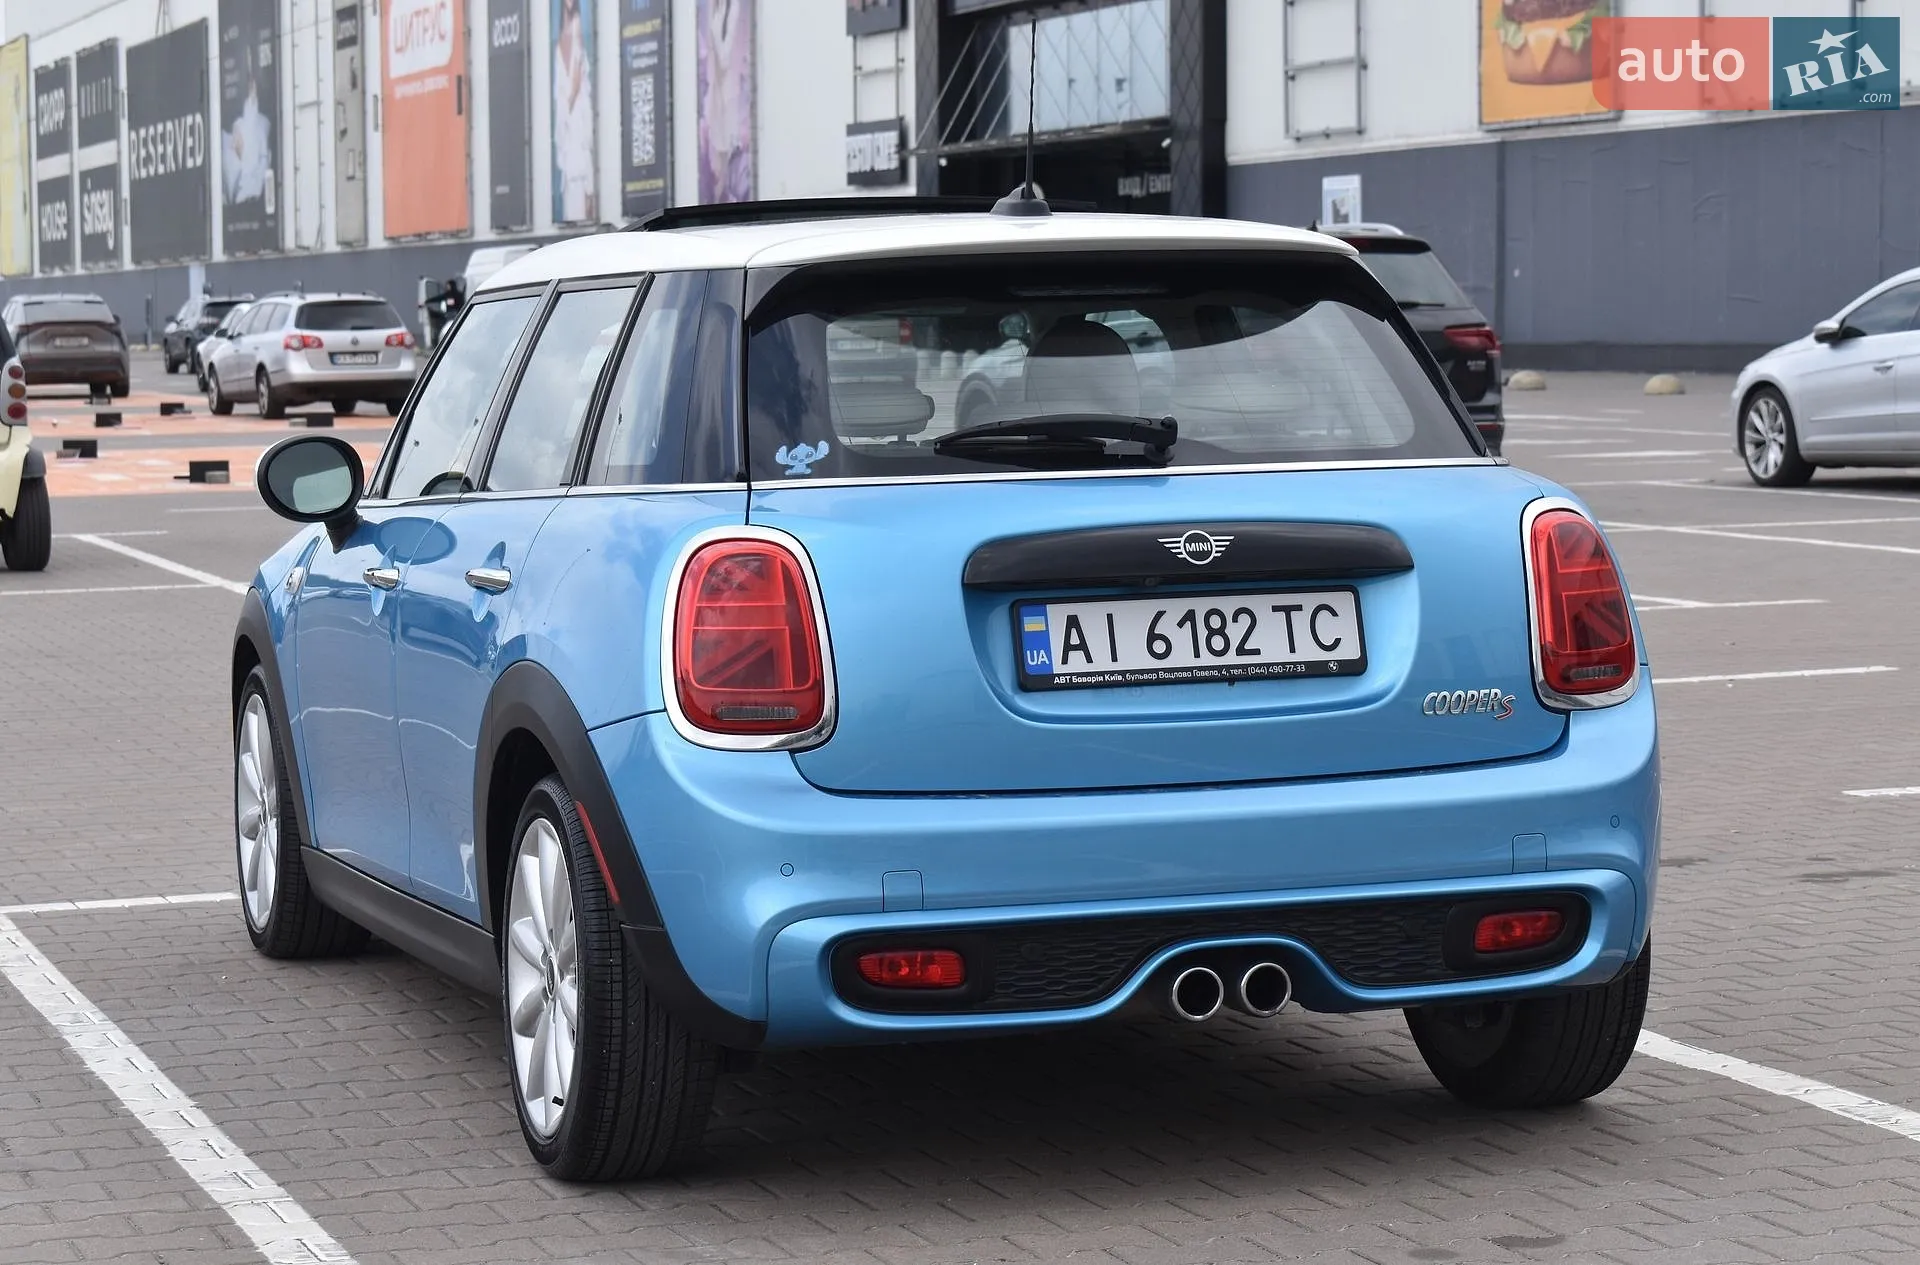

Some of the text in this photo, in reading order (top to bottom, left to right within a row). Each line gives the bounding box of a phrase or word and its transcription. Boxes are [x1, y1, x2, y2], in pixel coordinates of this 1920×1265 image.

[393, 0, 448, 55] ЦИТРУС
[130, 111, 205, 181] RESERVED
[1184, 541, 1212, 552] MINI
[1060, 603, 1342, 666] AI 6182 TC
[1026, 649, 1050, 666] UA
[1053, 676, 1071, 685] АВТ
[1072, 674, 1104, 684] Баварія
[1248, 665, 1268, 676] (044)
[1269, 664, 1306, 673] 490-77-33
[1422, 688, 1502, 716] COOPER
